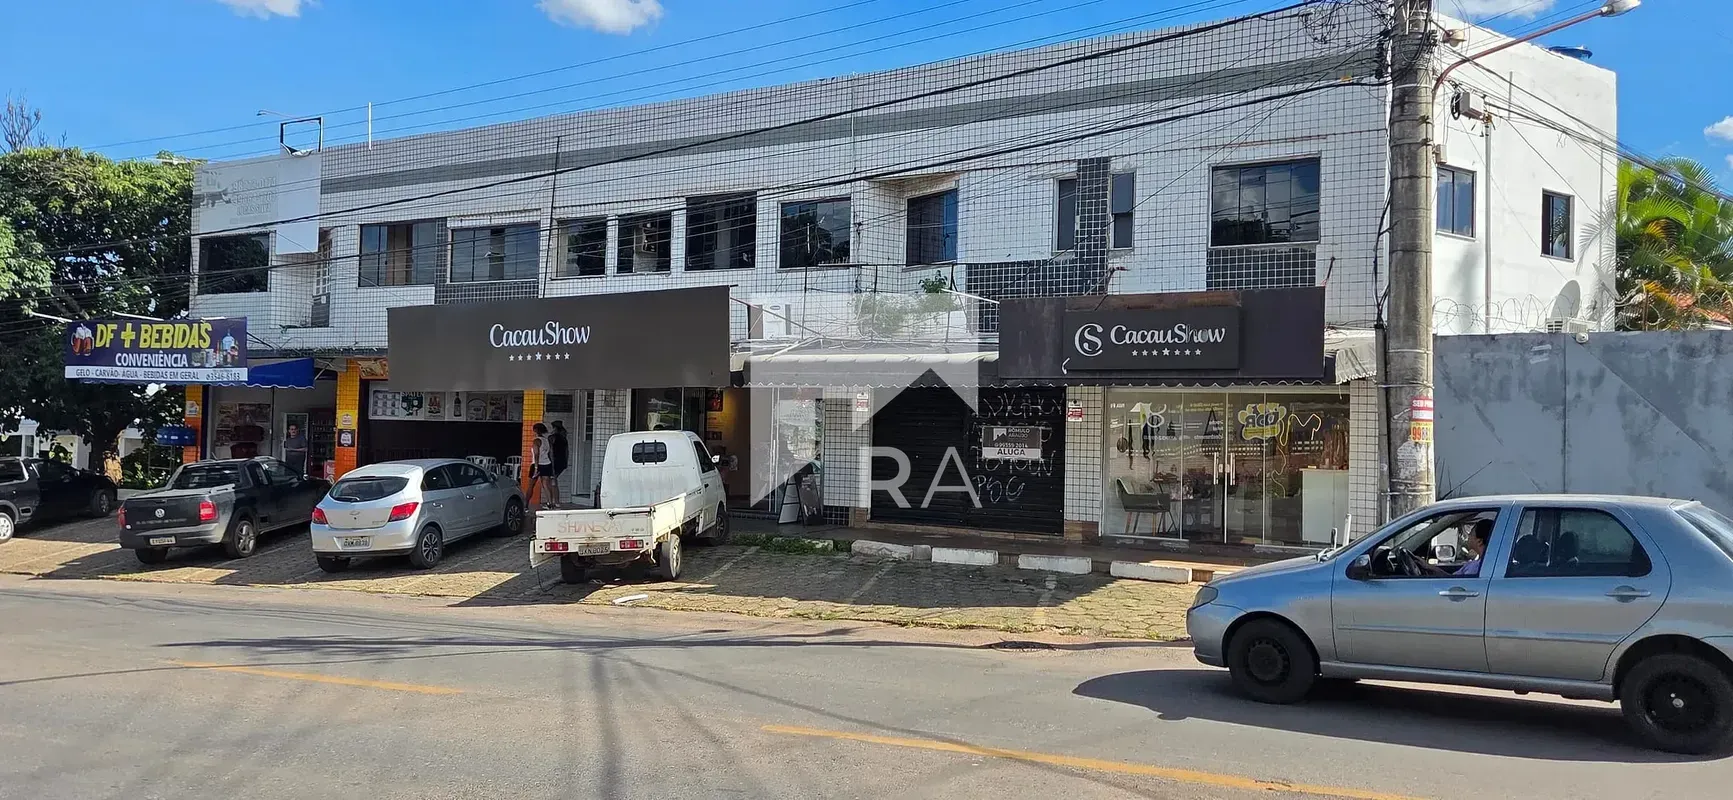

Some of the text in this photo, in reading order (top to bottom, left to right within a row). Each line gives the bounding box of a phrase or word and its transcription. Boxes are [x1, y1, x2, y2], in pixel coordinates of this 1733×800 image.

[95, 323, 118, 348] DF
[139, 323, 212, 348] BEBIDAS
[115, 350, 189, 368] CONVENIÊNCIA
[75, 368, 90, 377] GELO
[143, 370, 168, 379] BEBIDAS
[169, 371, 178, 379] EM
[180, 371, 200, 380] GERAL
[996, 448, 1026, 456] ALUGA
